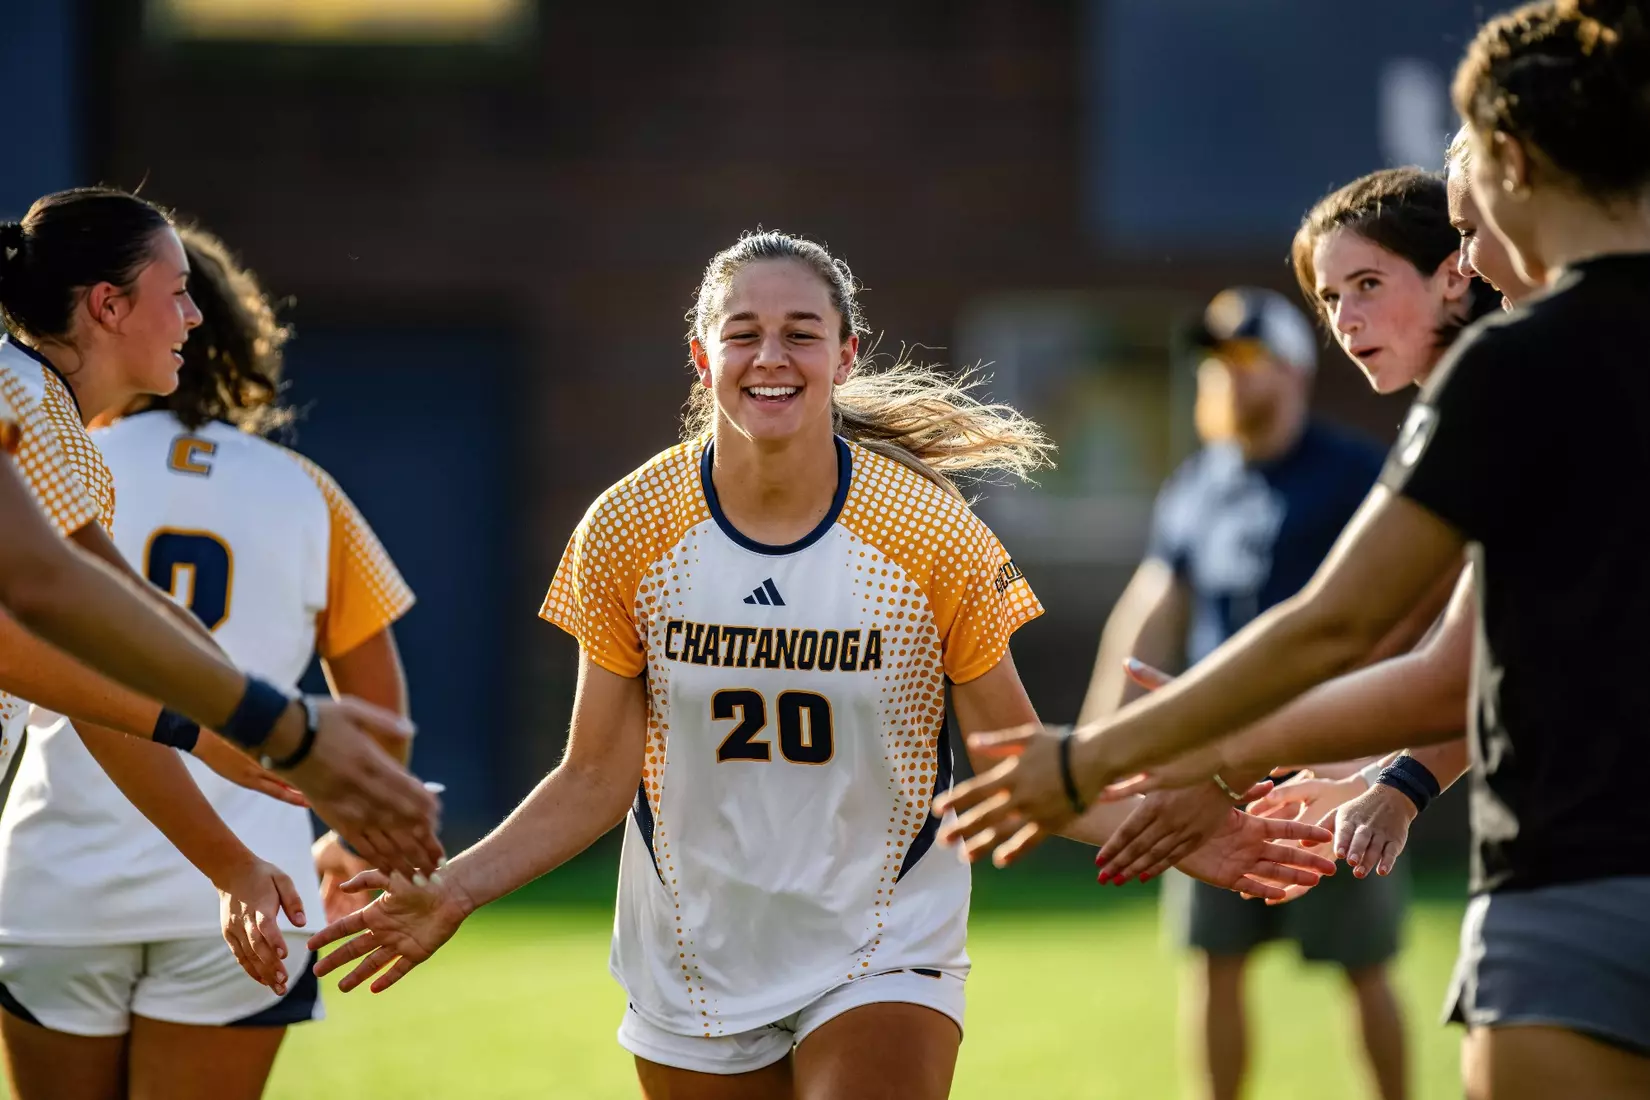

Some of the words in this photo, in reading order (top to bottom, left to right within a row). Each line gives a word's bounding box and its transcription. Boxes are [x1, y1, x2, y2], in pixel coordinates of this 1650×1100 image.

[167, 434, 219, 478] C
[665, 619, 883, 672] CHATTANOOGA
[710, 688, 835, 766] 20
